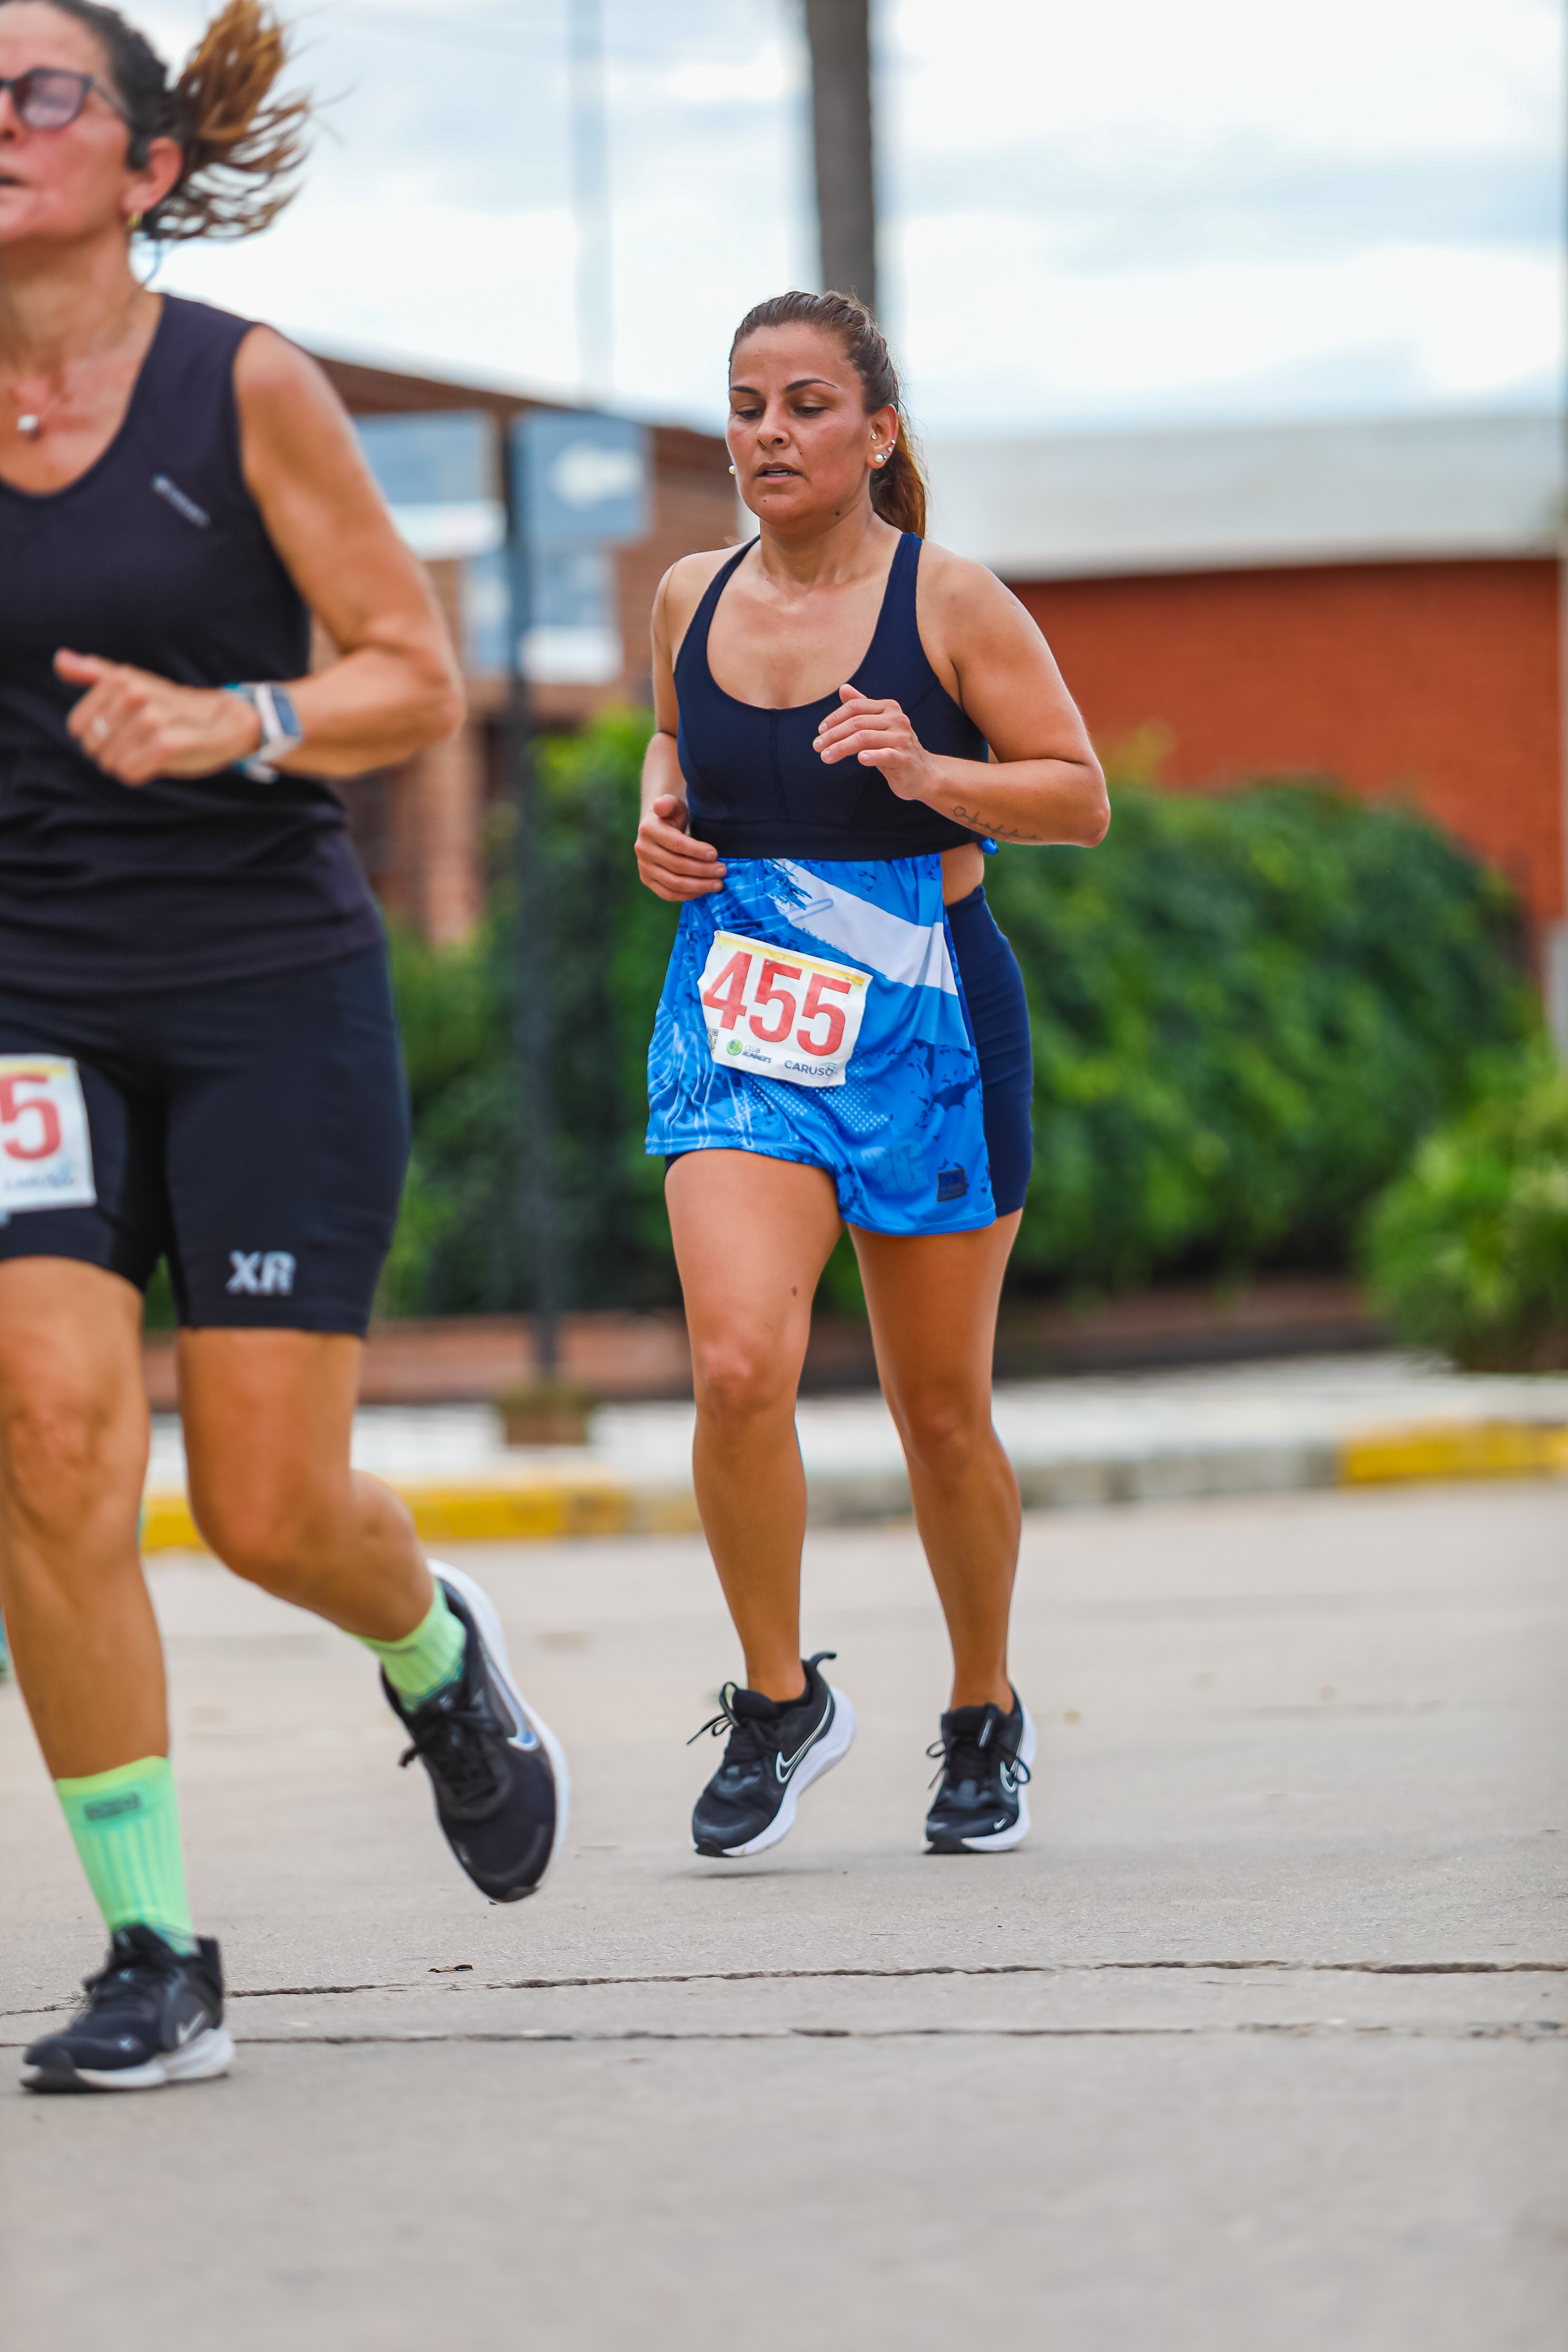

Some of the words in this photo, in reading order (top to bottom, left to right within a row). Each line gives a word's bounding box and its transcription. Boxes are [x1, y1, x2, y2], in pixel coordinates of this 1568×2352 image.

[703, 950, 851, 1056] 455
[785, 1060, 834, 1076] CARUSO
[0, 1072, 61, 1160] 5
[227, 1250, 296, 1295] XR
